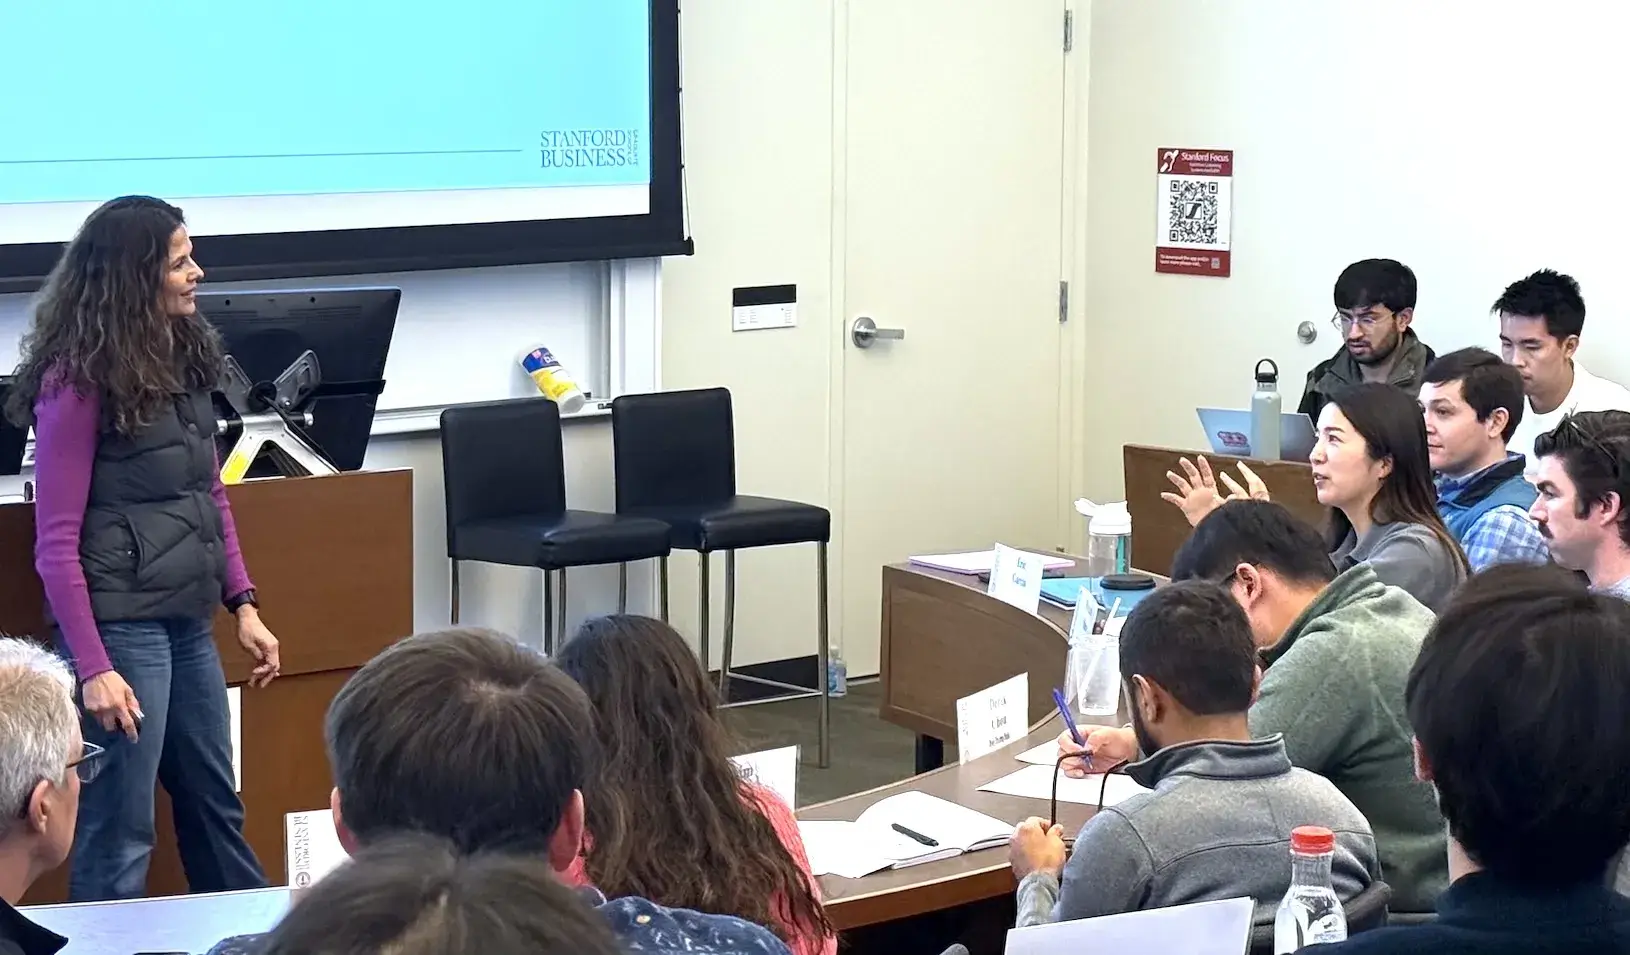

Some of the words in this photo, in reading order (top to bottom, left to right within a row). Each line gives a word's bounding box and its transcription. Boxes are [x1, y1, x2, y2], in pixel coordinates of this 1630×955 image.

[541, 130, 626, 147] STANFORD
[541, 149, 626, 168] BUSINESS
[1181, 152, 1209, 161] Stanford
[1210, 153, 1229, 162] Focus
